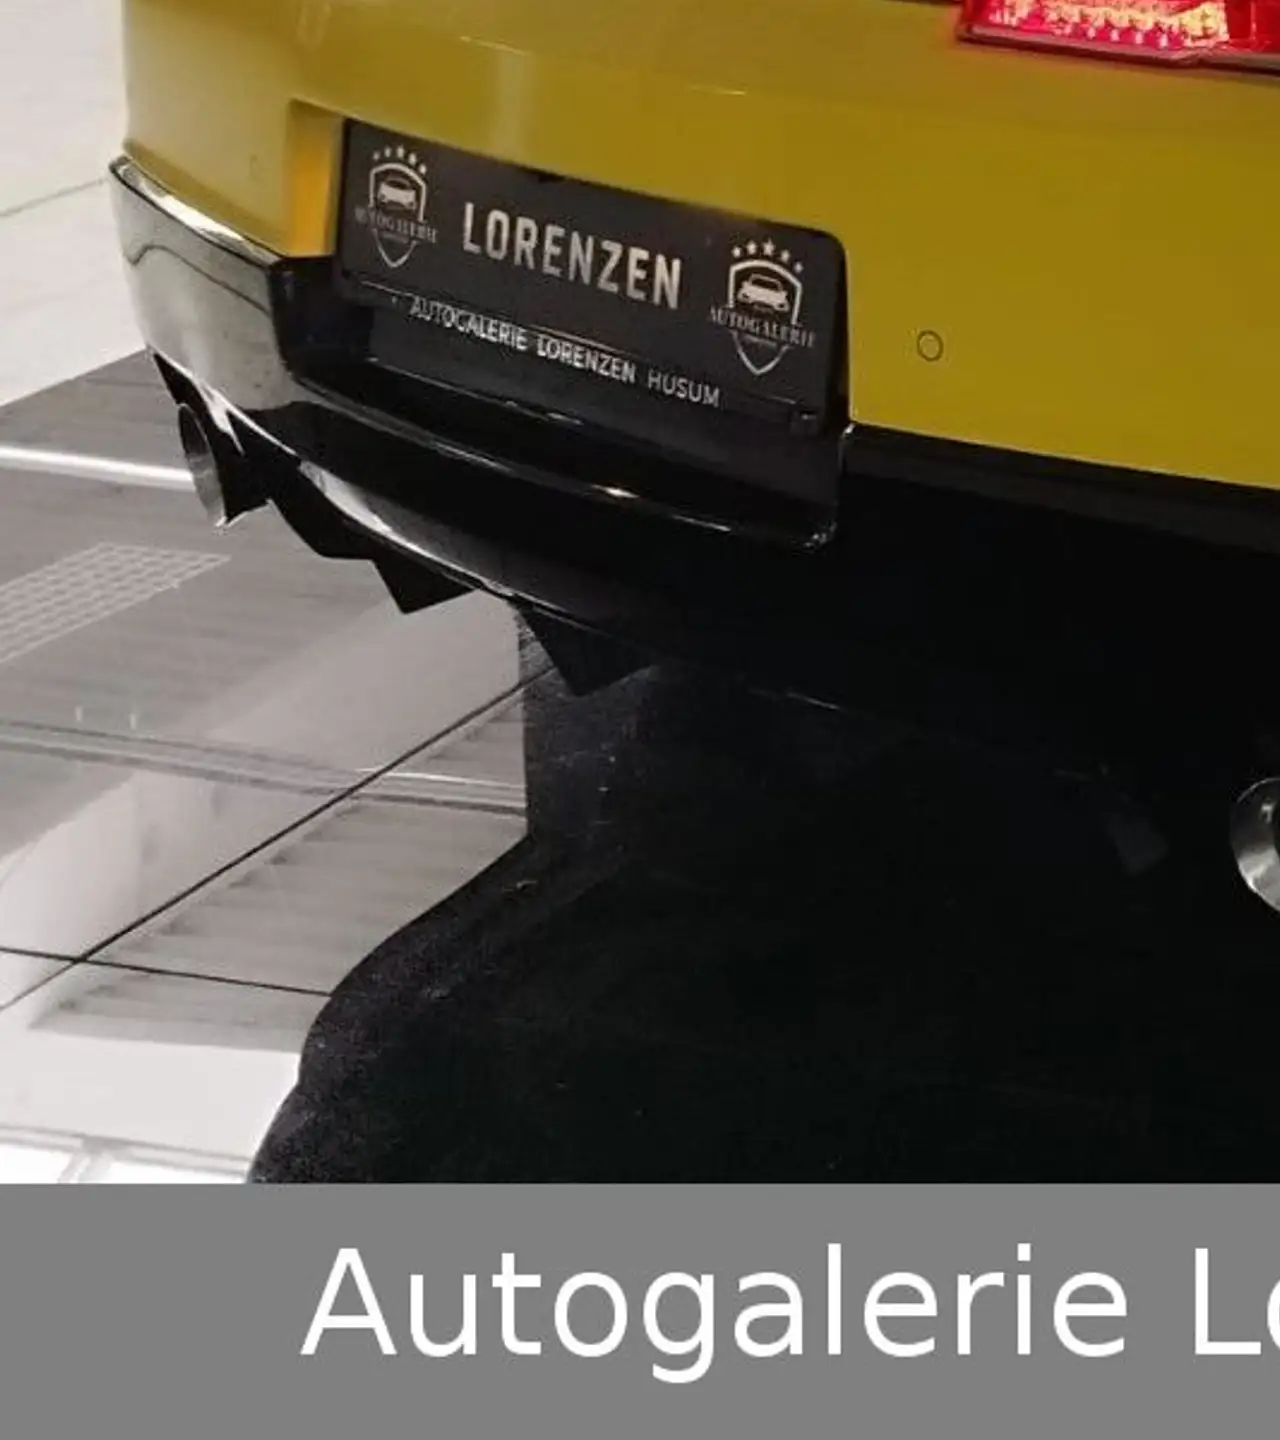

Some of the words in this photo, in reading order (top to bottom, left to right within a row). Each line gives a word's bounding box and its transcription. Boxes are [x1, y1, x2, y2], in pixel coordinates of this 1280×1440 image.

[462, 201, 682, 310] LORENZEN
[536, 334, 637, 385] LORENZEN
[647, 367, 721, 409] HUSUM
